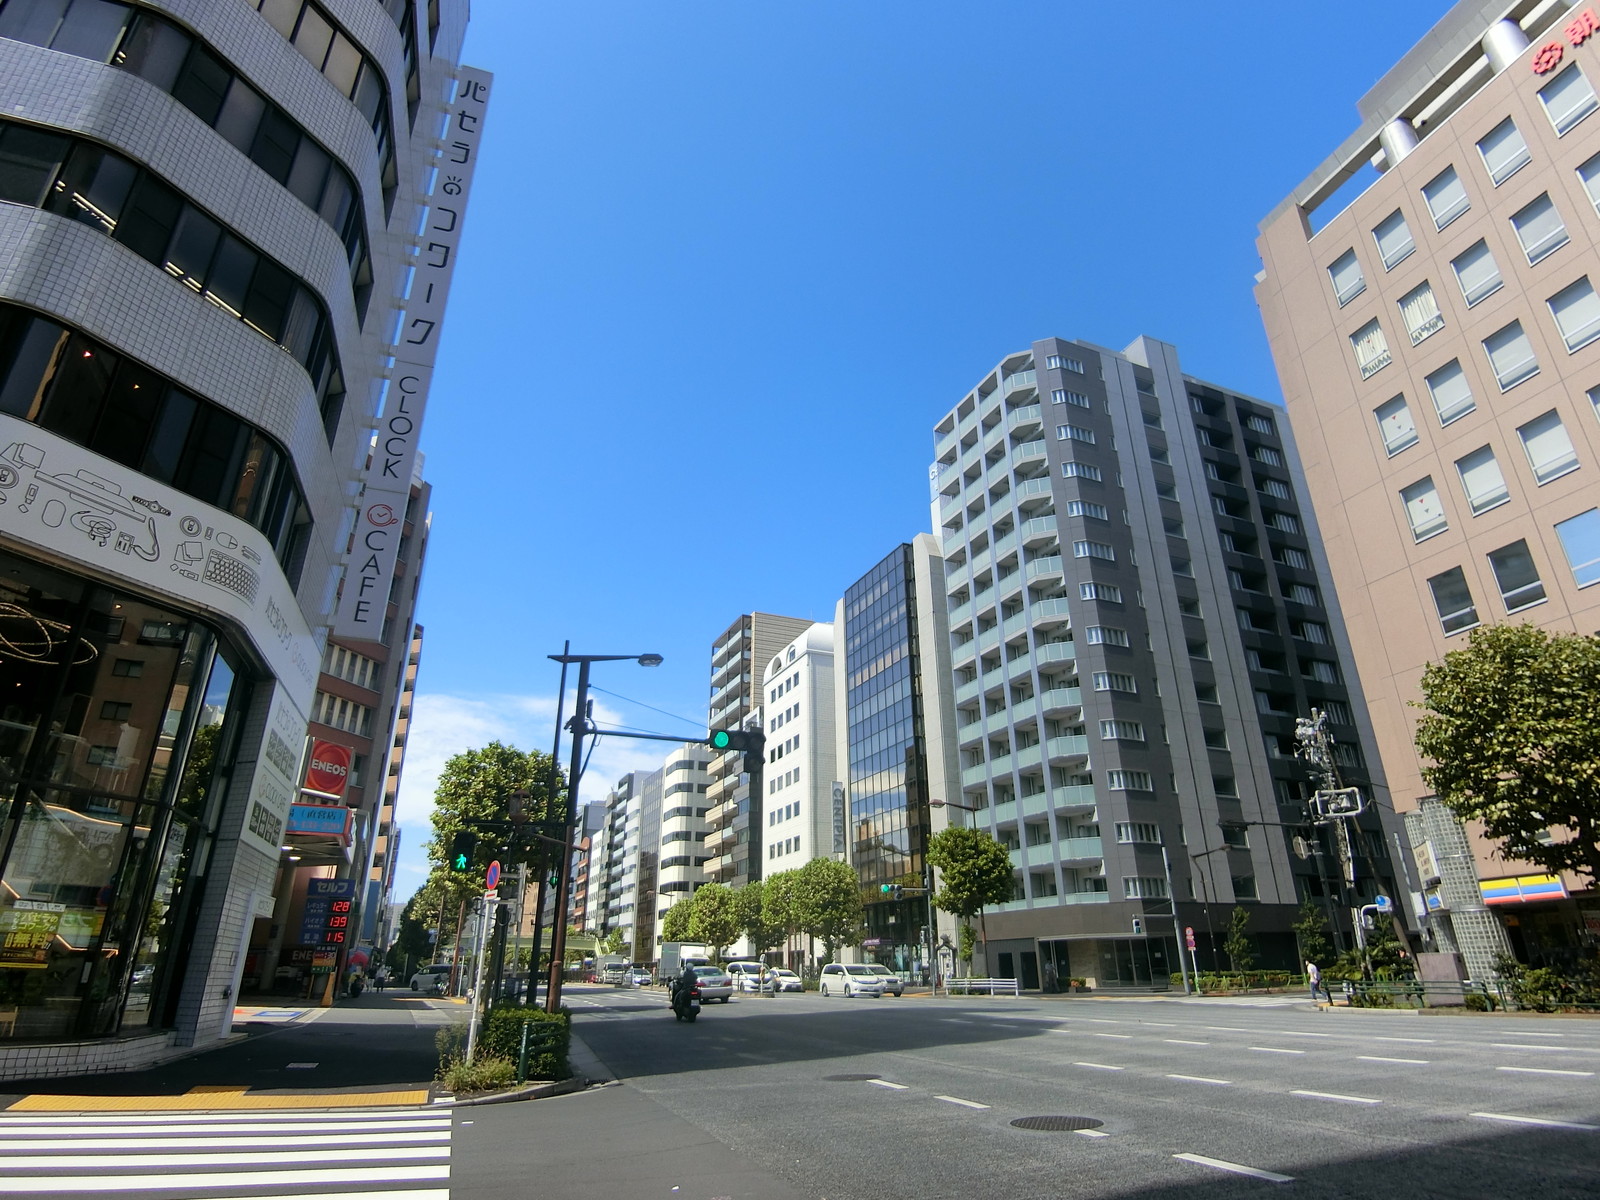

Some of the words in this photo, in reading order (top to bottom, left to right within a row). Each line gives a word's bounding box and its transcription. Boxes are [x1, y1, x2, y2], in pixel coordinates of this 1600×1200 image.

[1563, 7, 1600, 45] 朝
[382, 376, 420, 480] CLOCK
[353, 530, 388, 623] CAFE
[311, 759, 347, 776] ENEOS
[317, 881, 349, 893] セルフ
[332, 901, 350, 912] 128
[329, 916, 347, 927] 139
[326, 931, 344, 942] 115
